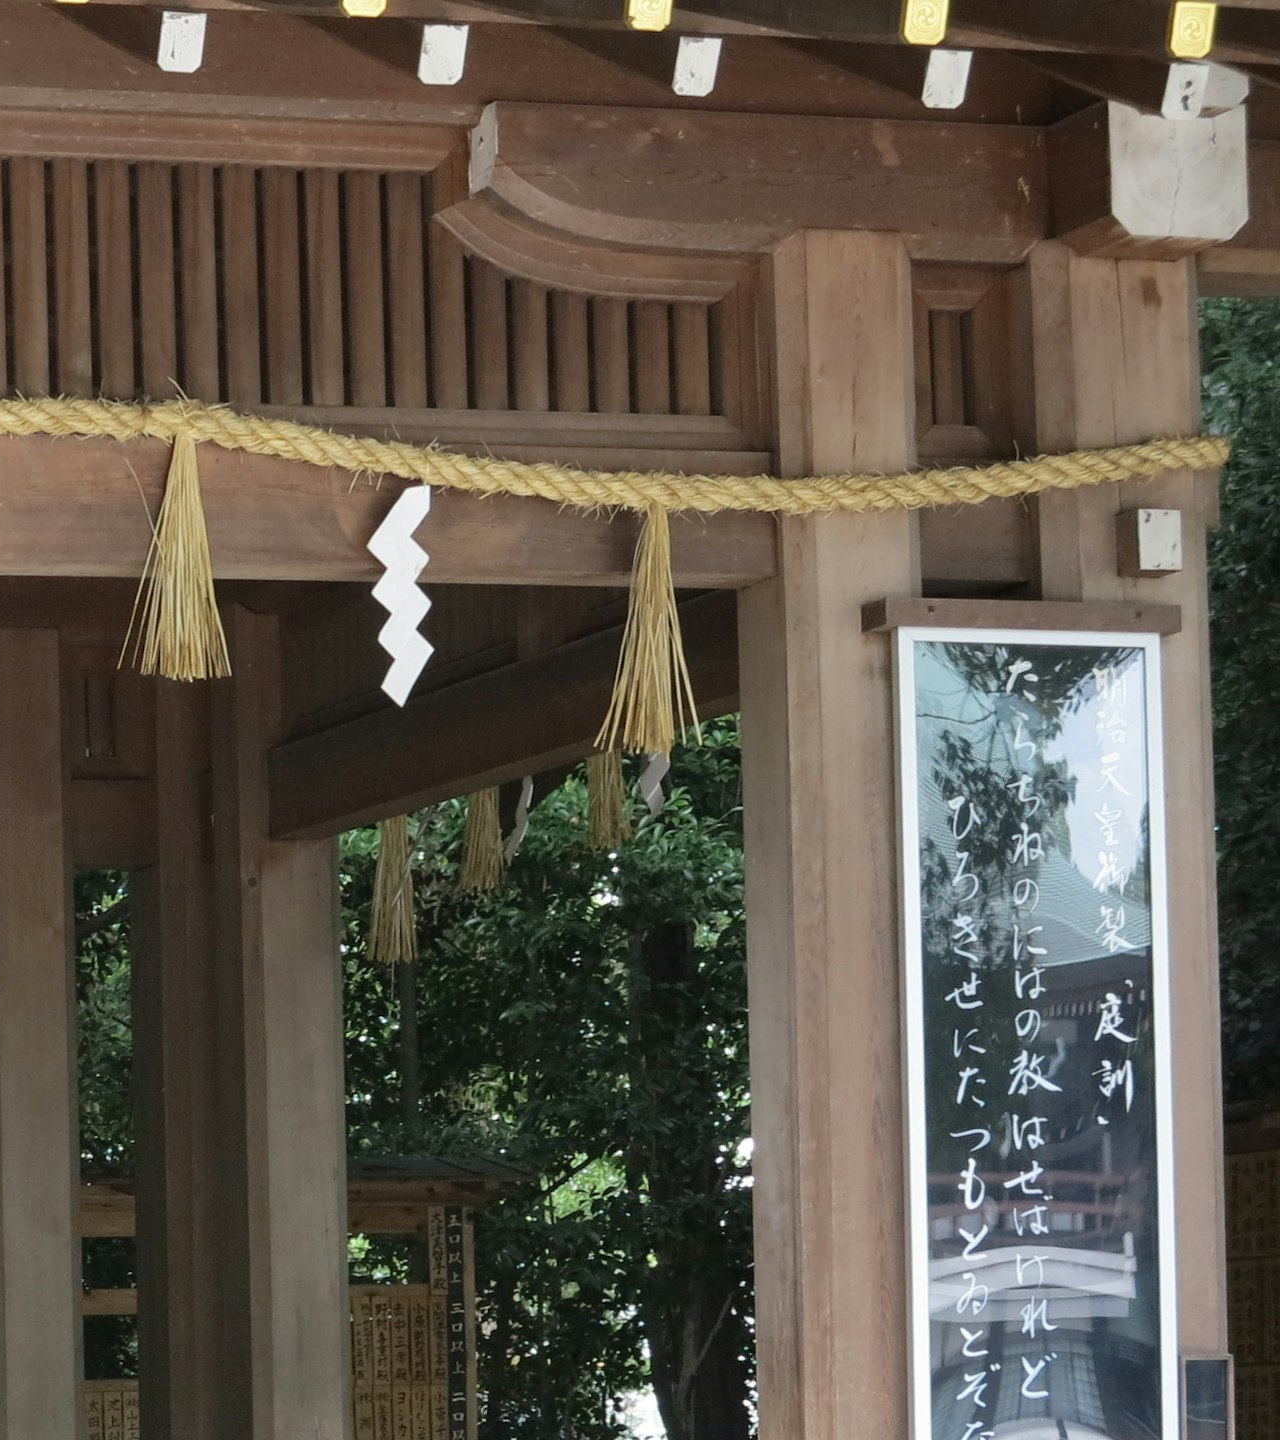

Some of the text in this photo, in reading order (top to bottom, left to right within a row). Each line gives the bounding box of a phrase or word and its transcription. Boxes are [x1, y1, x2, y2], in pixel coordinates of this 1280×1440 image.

[447, 1213, 463, 1284] 五口以上
[449, 1302, 465, 1375] 三口以上
